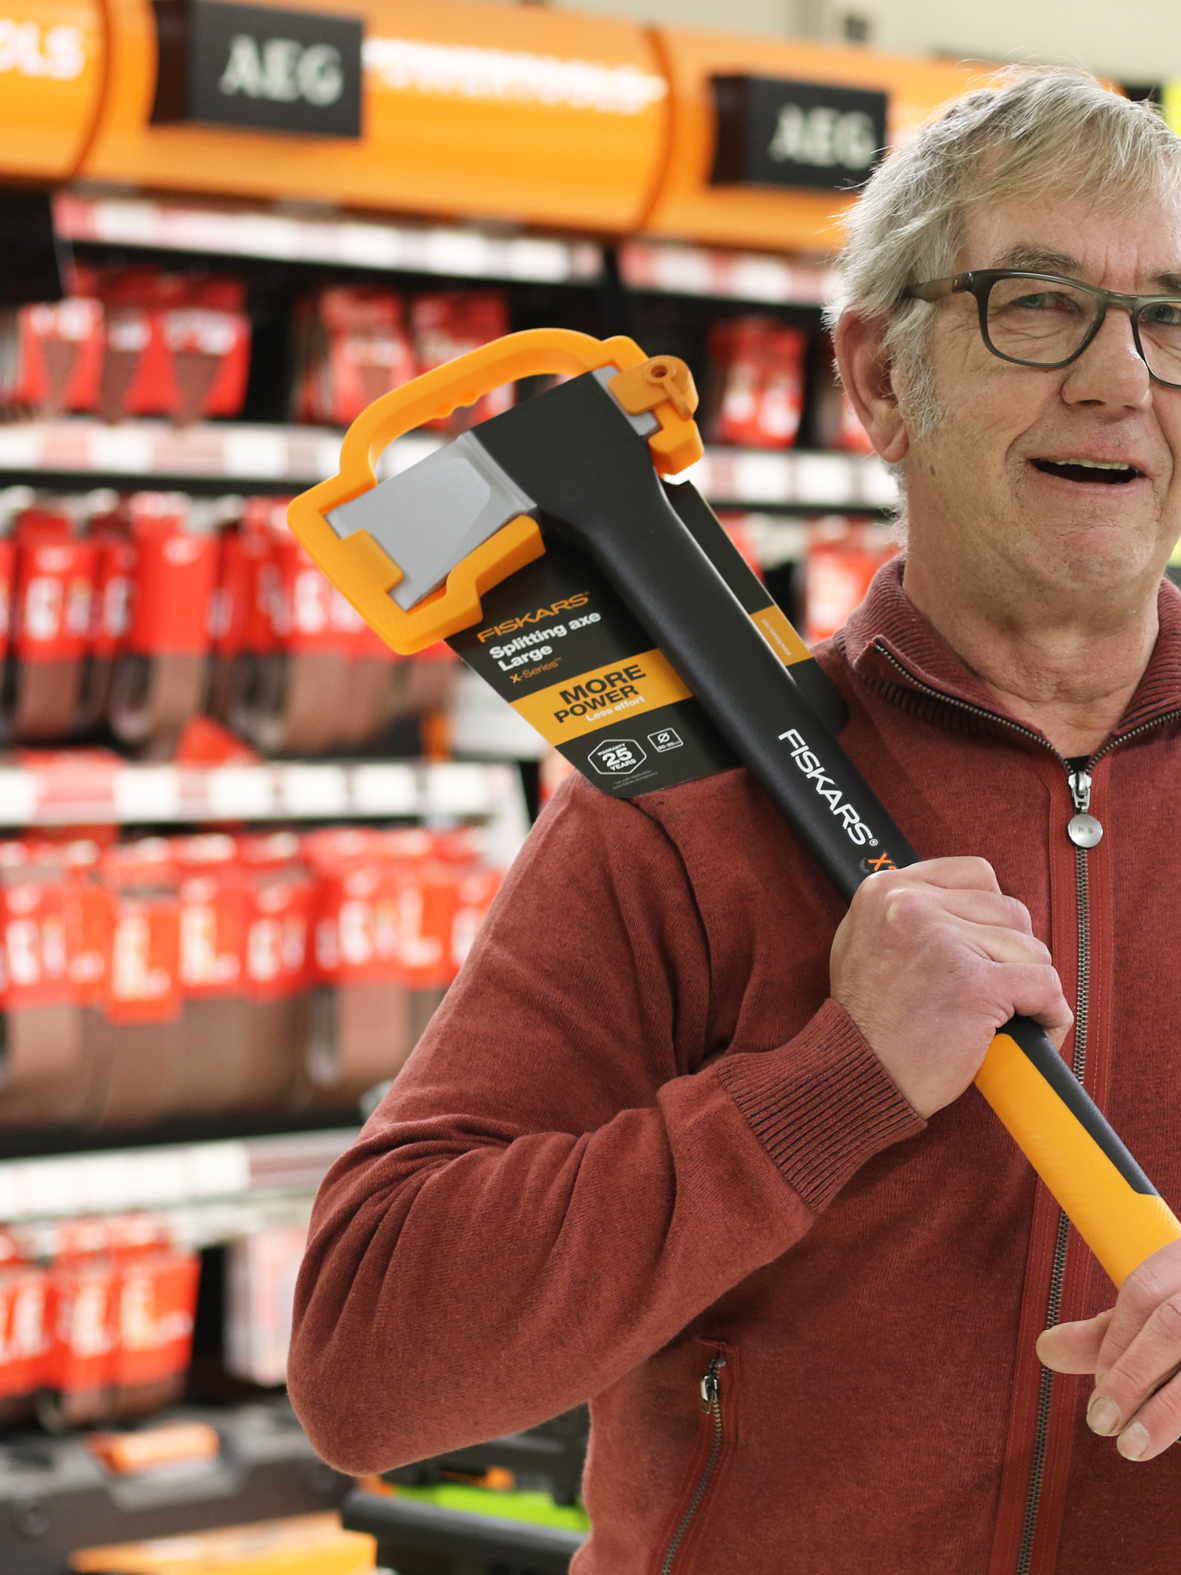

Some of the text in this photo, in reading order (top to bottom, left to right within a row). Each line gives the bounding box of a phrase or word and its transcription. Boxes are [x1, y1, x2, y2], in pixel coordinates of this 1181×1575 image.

[218, 35, 345, 107] AEG
[768, 102, 877, 171] AEG
[489, 612, 602, 660] Splitting axe
[497, 645, 553, 672] Large
[558, 664, 647, 705] MORE
[553, 685, 640, 724] POWER
[585, 695, 646, 722] Less effort
[602, 747, 633, 768] 25
[609, 758, 637, 772] YEARS
[867, 852, 898, 871] X
